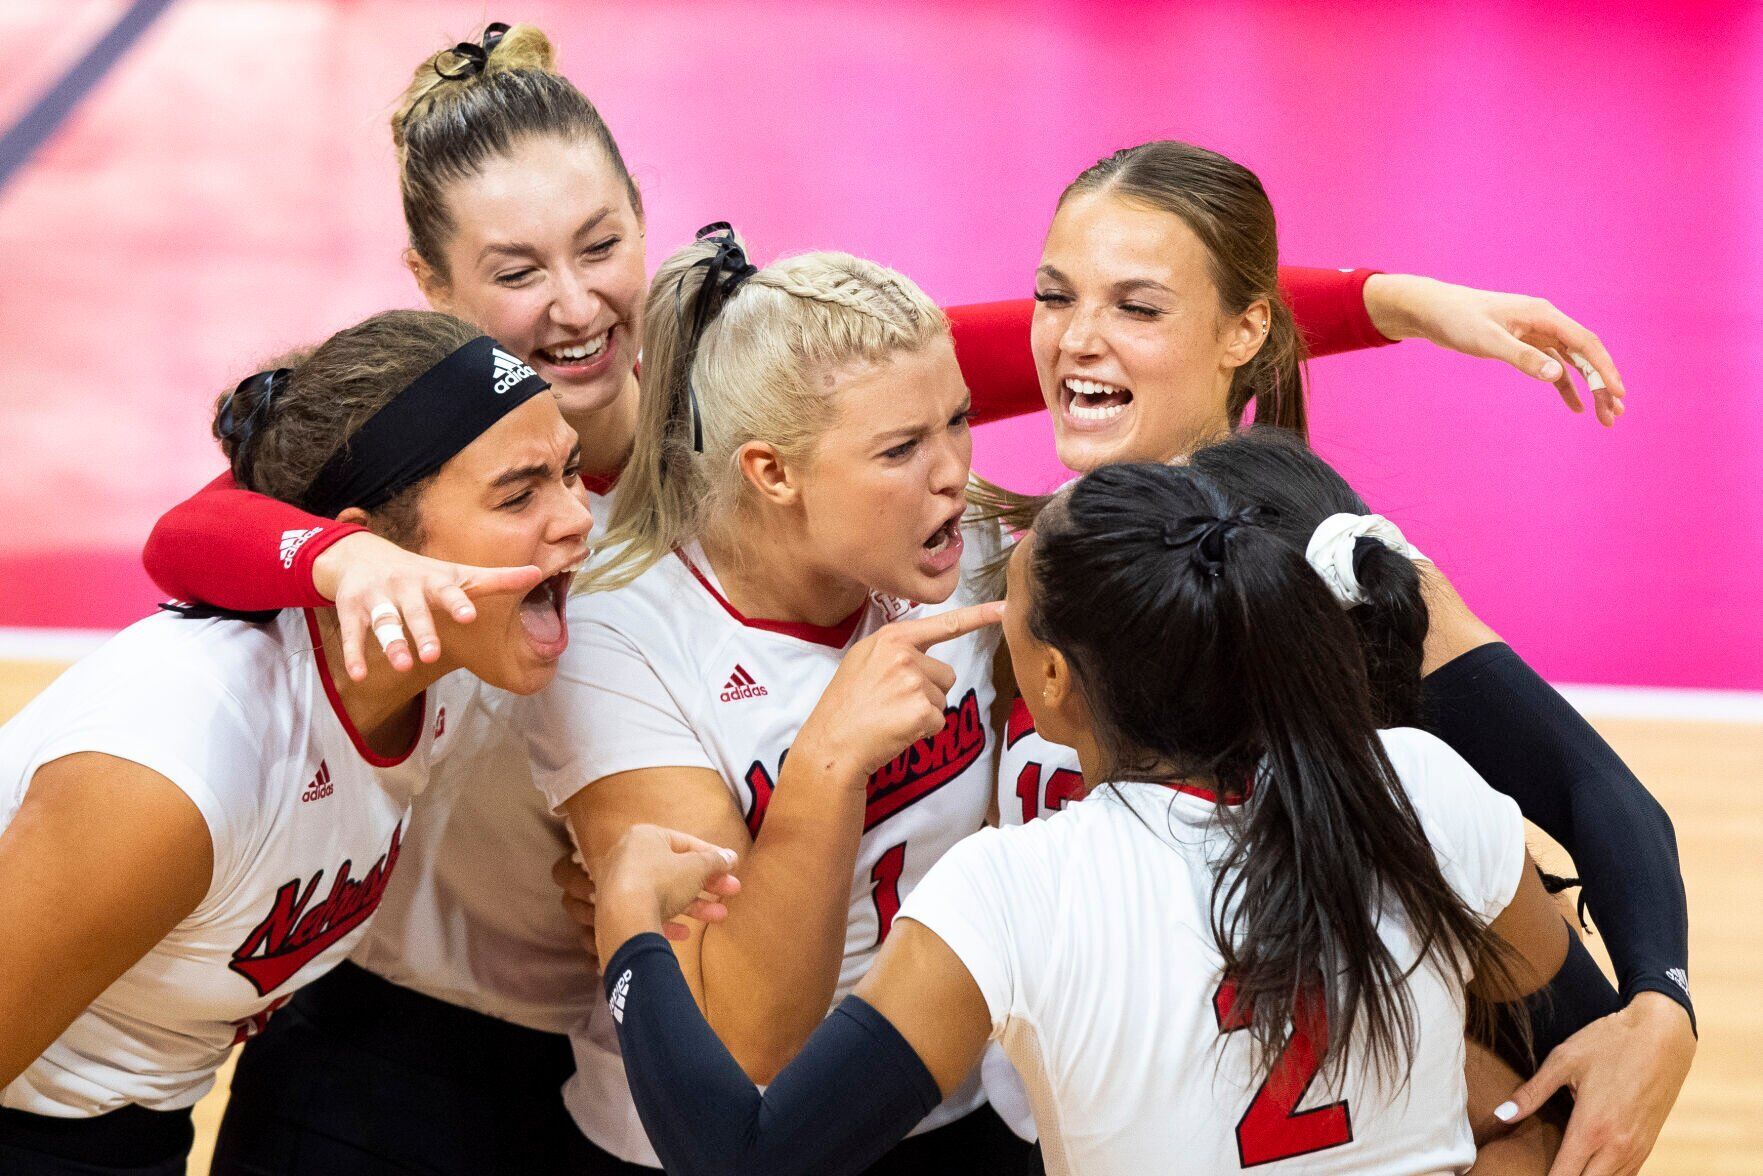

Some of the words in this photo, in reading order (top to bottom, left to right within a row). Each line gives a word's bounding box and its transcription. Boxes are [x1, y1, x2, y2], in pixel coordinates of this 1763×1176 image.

[493, 365, 538, 394] adida
[720, 684, 768, 702] adidas
[302, 783, 334, 803] adidas
[870, 840, 908, 946] 1
[1212, 963, 1354, 1169] 2
